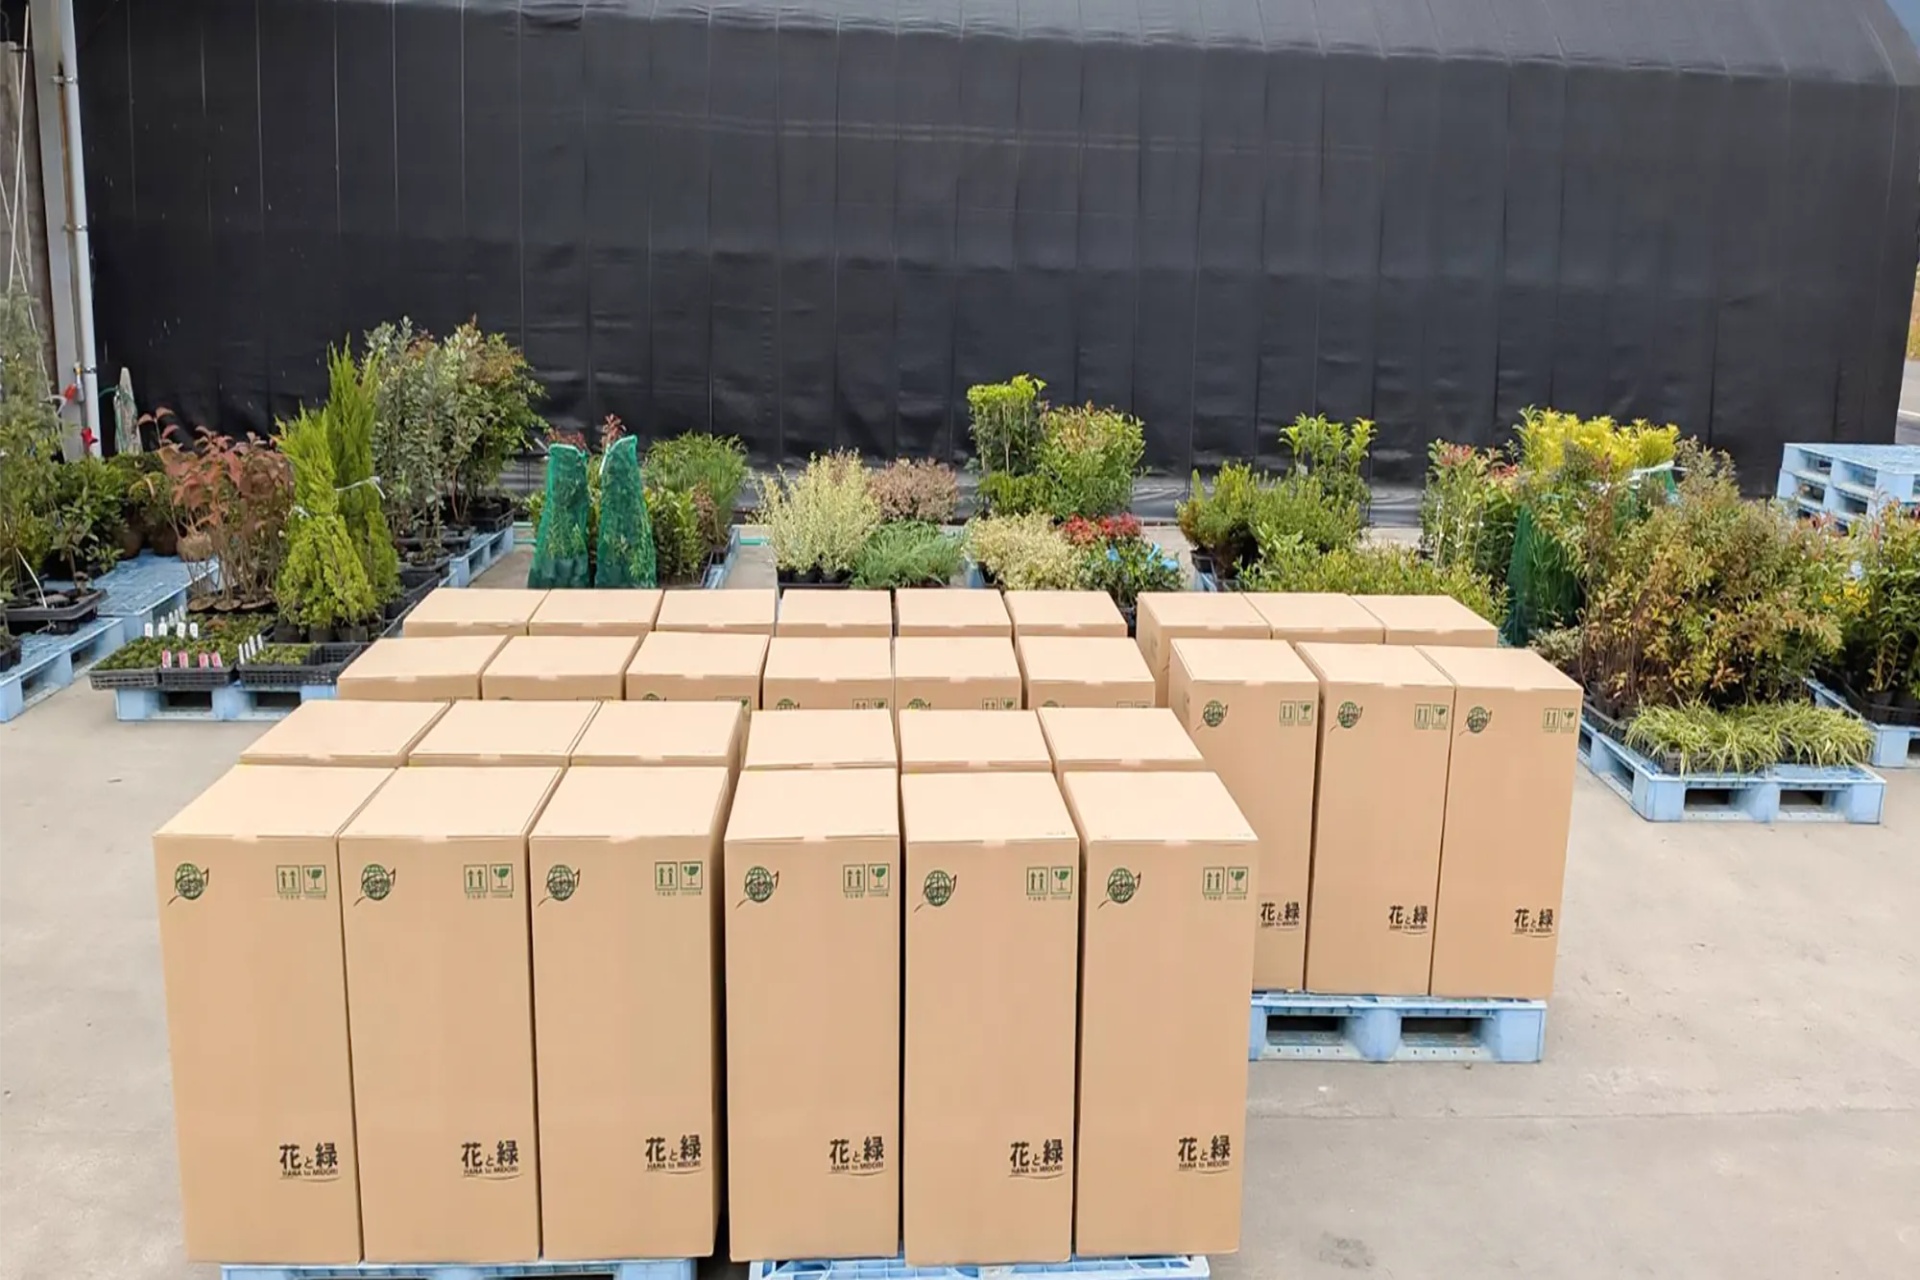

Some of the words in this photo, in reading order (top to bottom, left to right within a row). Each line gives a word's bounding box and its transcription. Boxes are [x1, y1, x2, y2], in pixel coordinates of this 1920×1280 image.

[1261, 902, 1300, 921] 花と緑
[1388, 904, 1428, 924] 花と緑
[1514, 908, 1553, 928] 花と緑
[279, 1142, 338, 1170] 花と緑
[461, 1140, 518, 1169] 花と緑
[645, 1135, 702, 1163] 花と緑
[829, 1136, 884, 1165] 花と緑
[1010, 1139, 1063, 1168] 花と緑
[1177, 1135, 1231, 1163] 花と緑
